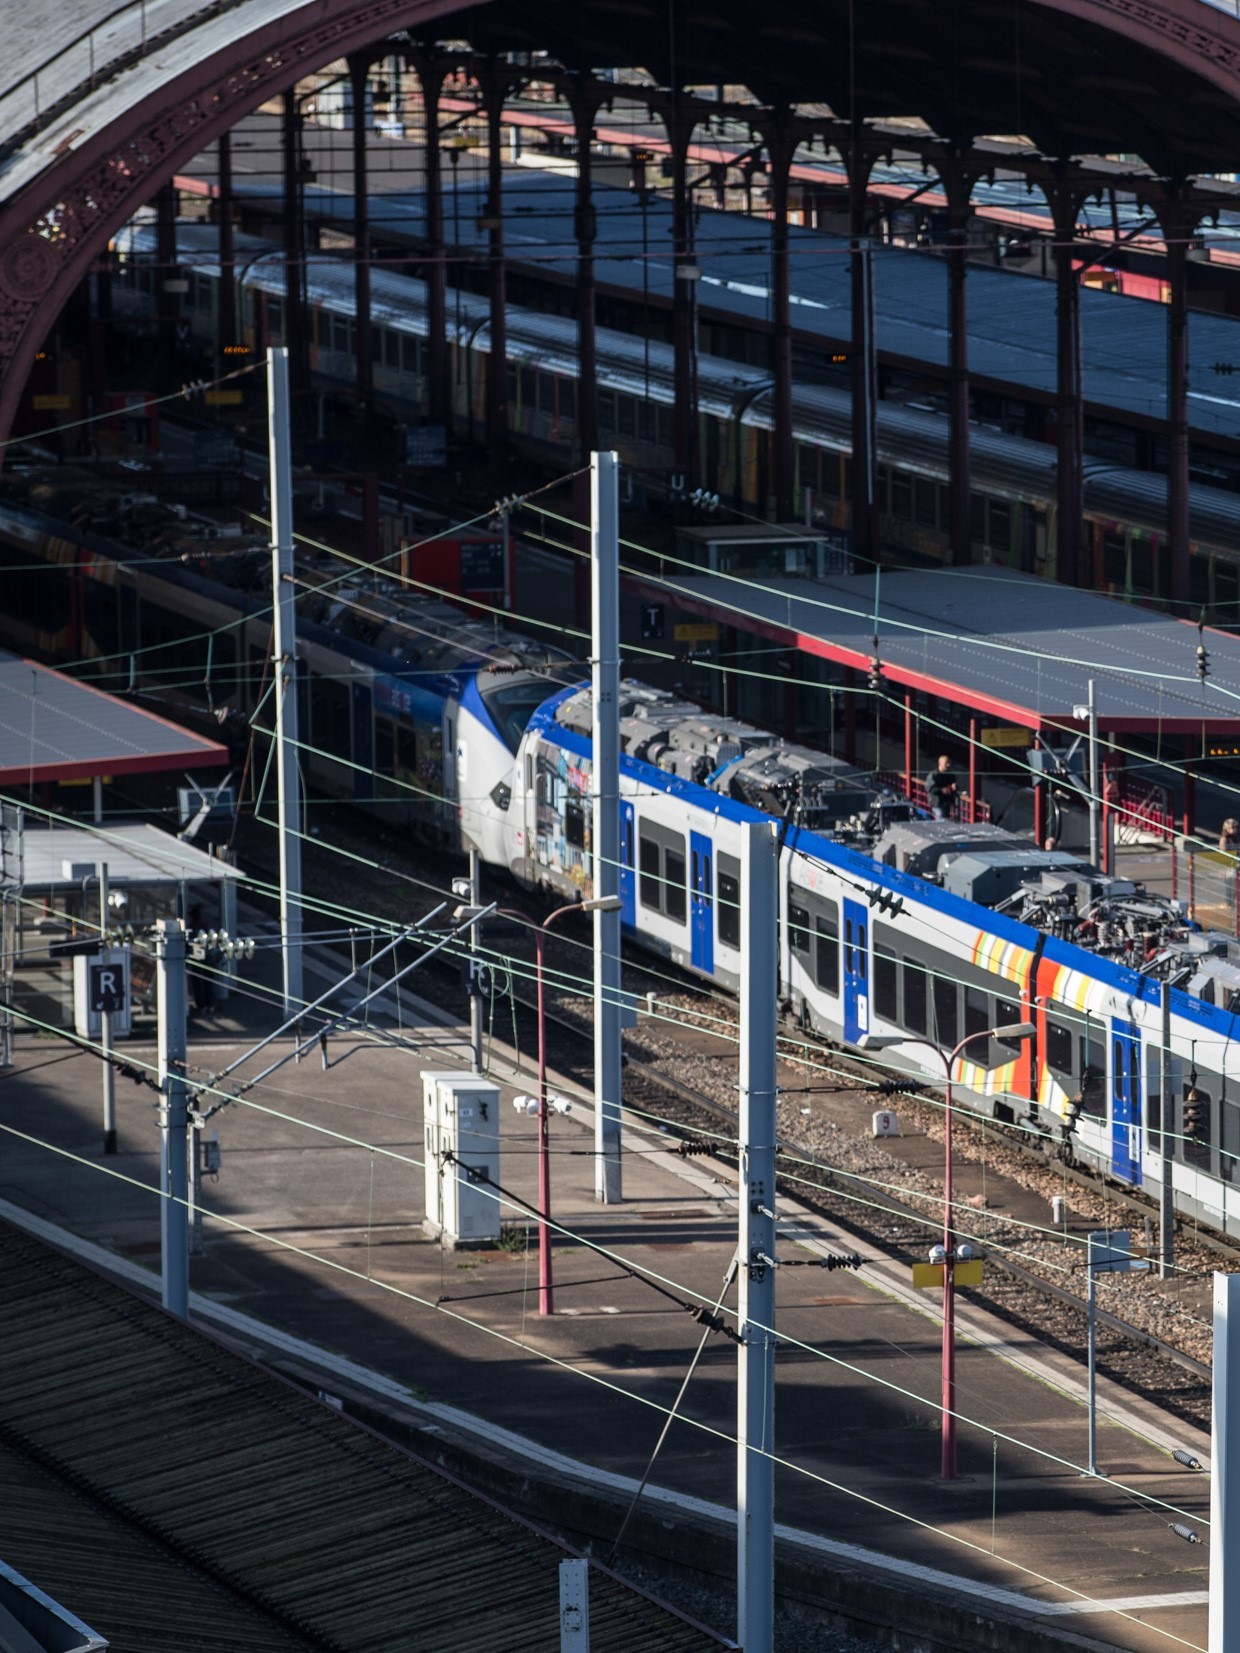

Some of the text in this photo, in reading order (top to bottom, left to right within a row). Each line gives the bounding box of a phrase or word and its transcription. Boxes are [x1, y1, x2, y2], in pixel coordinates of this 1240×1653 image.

[646, 607, 659, 626] T
[100, 972, 117, 995] R
[882, 1115, 890, 1130] 9
